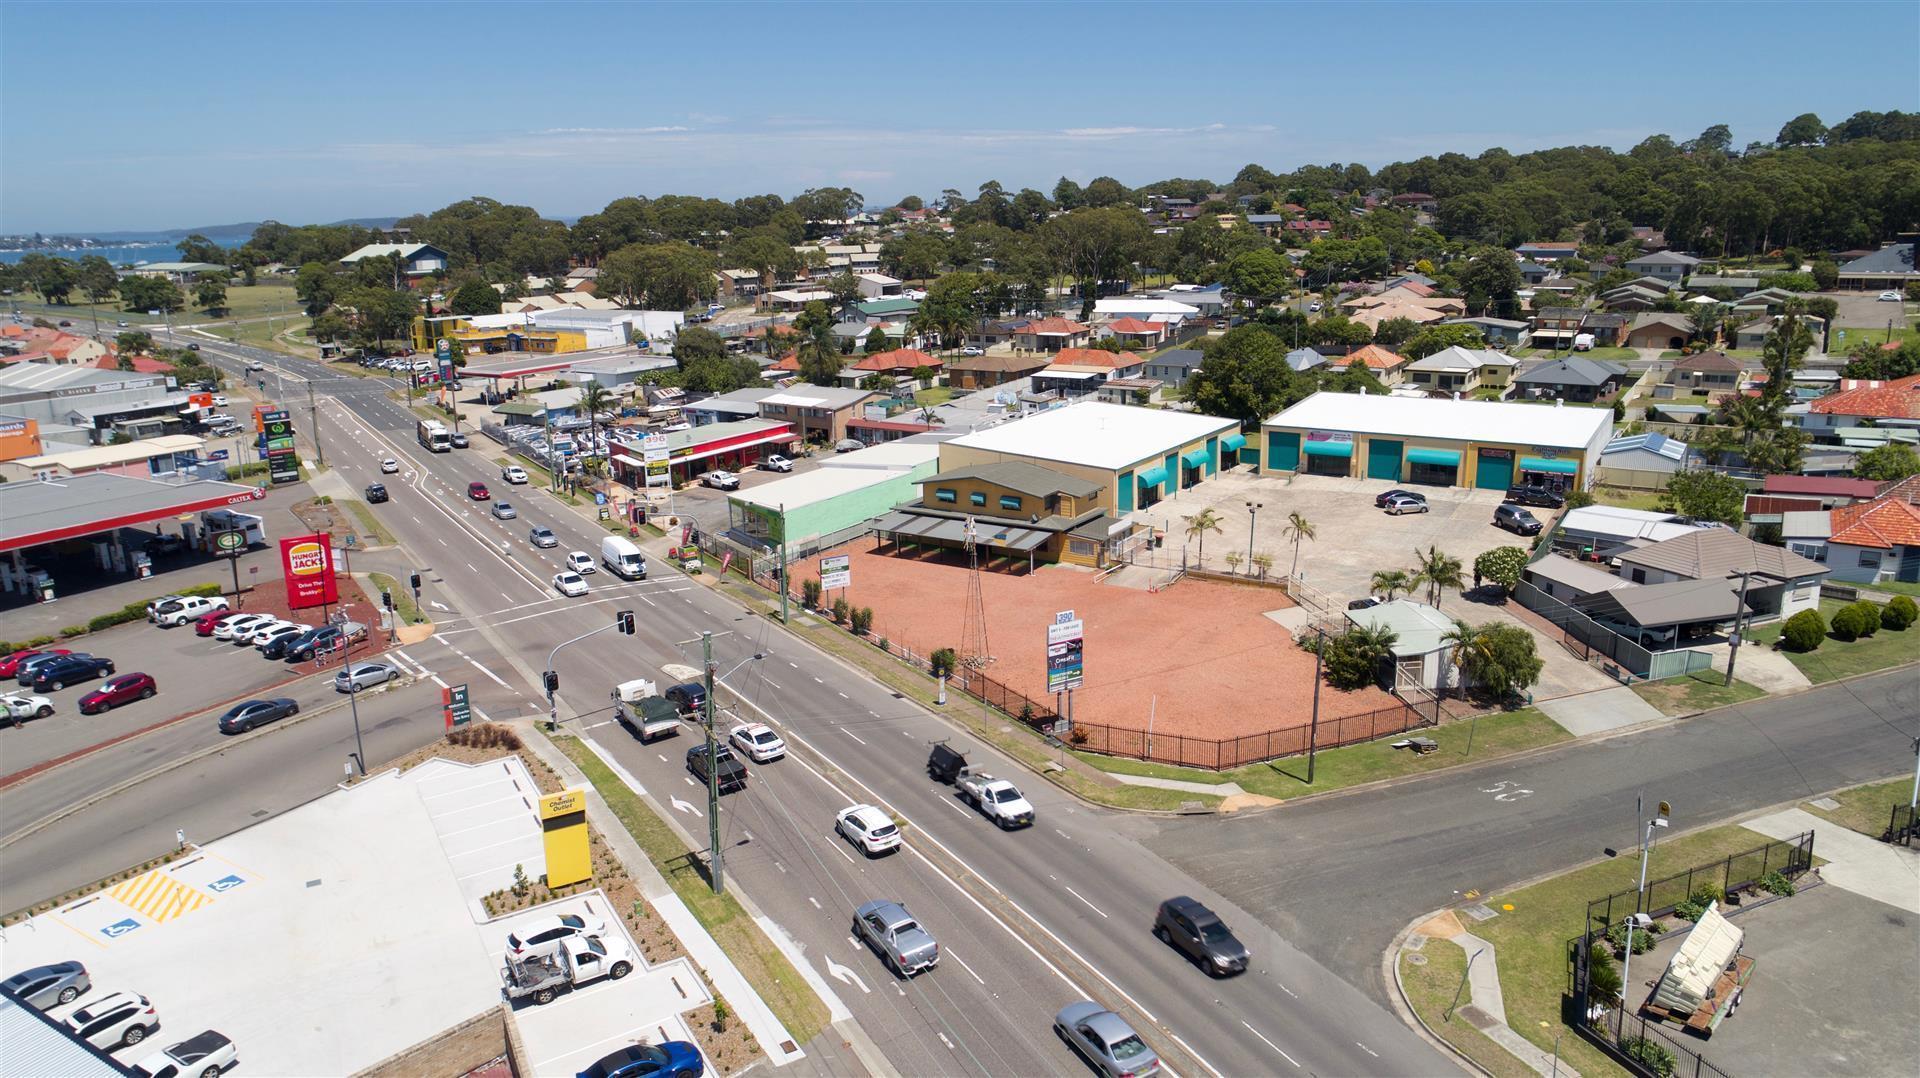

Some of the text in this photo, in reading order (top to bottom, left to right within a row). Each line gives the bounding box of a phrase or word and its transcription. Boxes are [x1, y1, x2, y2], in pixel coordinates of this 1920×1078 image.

[228, 495, 251, 504] CALTEX
[455, 693, 464, 701] In
[550, 797, 576, 808] Chemist
[553, 803, 574, 812] Outlet
